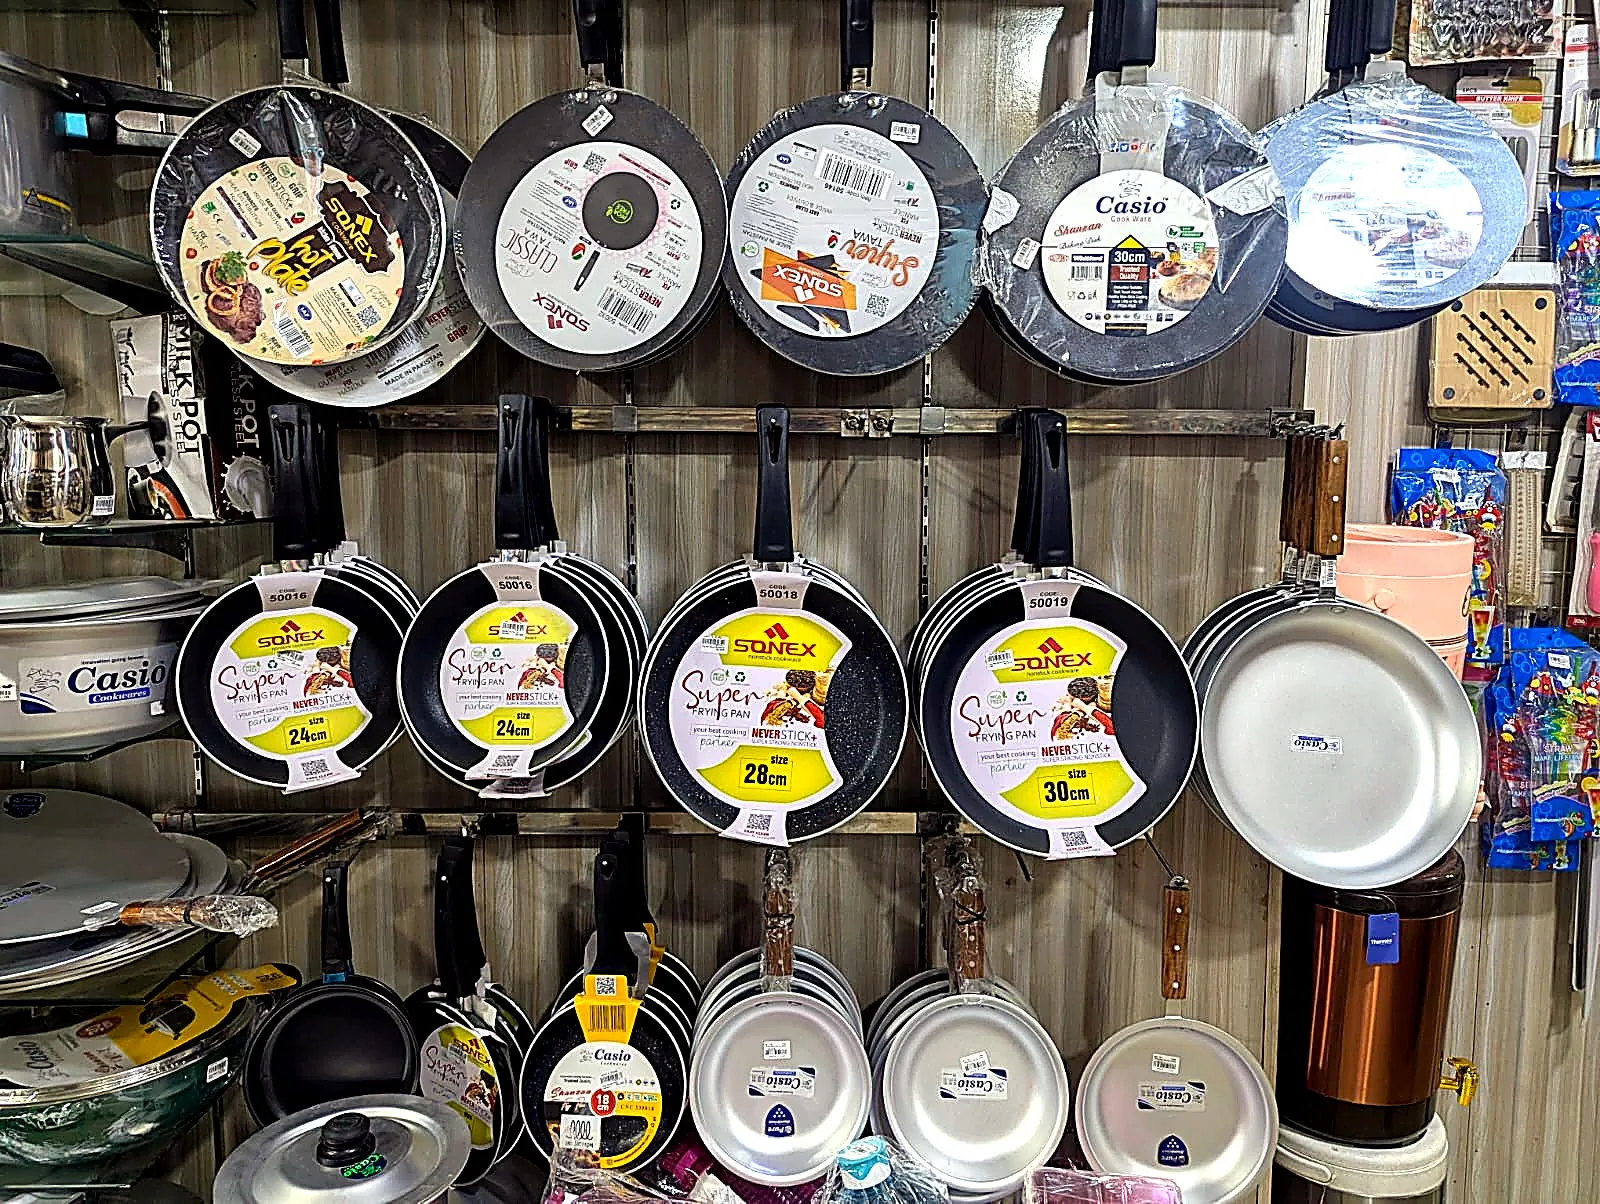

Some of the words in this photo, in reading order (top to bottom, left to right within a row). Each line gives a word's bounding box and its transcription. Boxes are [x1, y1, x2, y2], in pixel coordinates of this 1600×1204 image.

[1096, 196, 1166, 214] Casio
[324, 197, 378, 264] SONEX
[524, 227, 552, 248] TAWA
[852, 228, 882, 248] TAWA
[290, 233, 336, 268] hot
[500, 228, 558, 274] CLASSIC
[1115, 252, 1145, 263] 30cm
[246, 236, 309, 296] Plate
[841, 238, 920, 286] Super
[773, 264, 844, 297] SONEX
[532, 292, 590, 332] SONEX
[447, 324, 469, 342] GRIP
[168, 325, 178, 406] STAINLESS
[176, 324, 193, 392] MILK
[384, 375, 402, 386] MADE
[404, 370, 412, 378] IN
[412, 351, 444, 374] PAKISTAN
[179, 401, 201, 458] POT
[233, 407, 245, 448] STEEL
[240, 400, 260, 449] POT
[172, 412, 186, 457] STEEL
[499, 581, 532, 590] 50016
[270, 592, 307, 602] 50016
[760, 590, 798, 599] 50018
[1030, 597, 1068, 609] 50019
[258, 630, 325, 648] SONEX
[488, 625, 547, 636] SEX
[734, 640, 816, 657] SONEX
[448, 649, 516, 688] Super
[1011, 652, 1093, 672] SONEX
[67, 660, 166, 694] Casio
[218, 665, 296, 703] Super
[92, 690, 147, 703] Cookwares
[234, 692, 268, 704] FRYING
[269, 688, 288, 698] PAN
[293, 695, 352, 710] NEVERSTICK+
[506, 692, 559, 701] NEVERSTICK+
[682, 670, 766, 721] Super
[308, 717, 324, 725] size
[516, 712, 531, 720] size
[692, 708, 728, 718] FRYING
[730, 710, 750, 719] PAN
[960, 696, 1046, 745] Super
[496, 720, 530, 736] 24cm
[722, 728, 747, 737] cooking
[752, 727, 817, 742] NEVERSTICK+
[976, 732, 1013, 742] FRYING
[1015, 730, 1036, 739] PAN
[289, 729, 327, 746] 24cm
[700, 734, 738, 747] partner
[1294, 740, 1328, 751] Casio
[980, 752, 994, 761] your
[1010, 750, 1036, 758] cooking
[1041, 743, 1111, 757] NEVERSTICK+
[771, 755, 788, 765] size
[990, 761, 1028, 776] partner
[744, 764, 787, 786] 28cm
[1068, 769, 1086, 779] size
[1044, 780, 1090, 802] 30cm
[454, 1039, 492, 1066] SONEX
[594, 1048, 631, 1062] Casio
[426, 1046, 466, 1080] Super
[767, 1077, 801, 1089] Casio
[958, 1078, 993, 1092] Casio
[596, 1094, 610, 1104] 18
[1156, 1090, 1191, 1103] Casio
